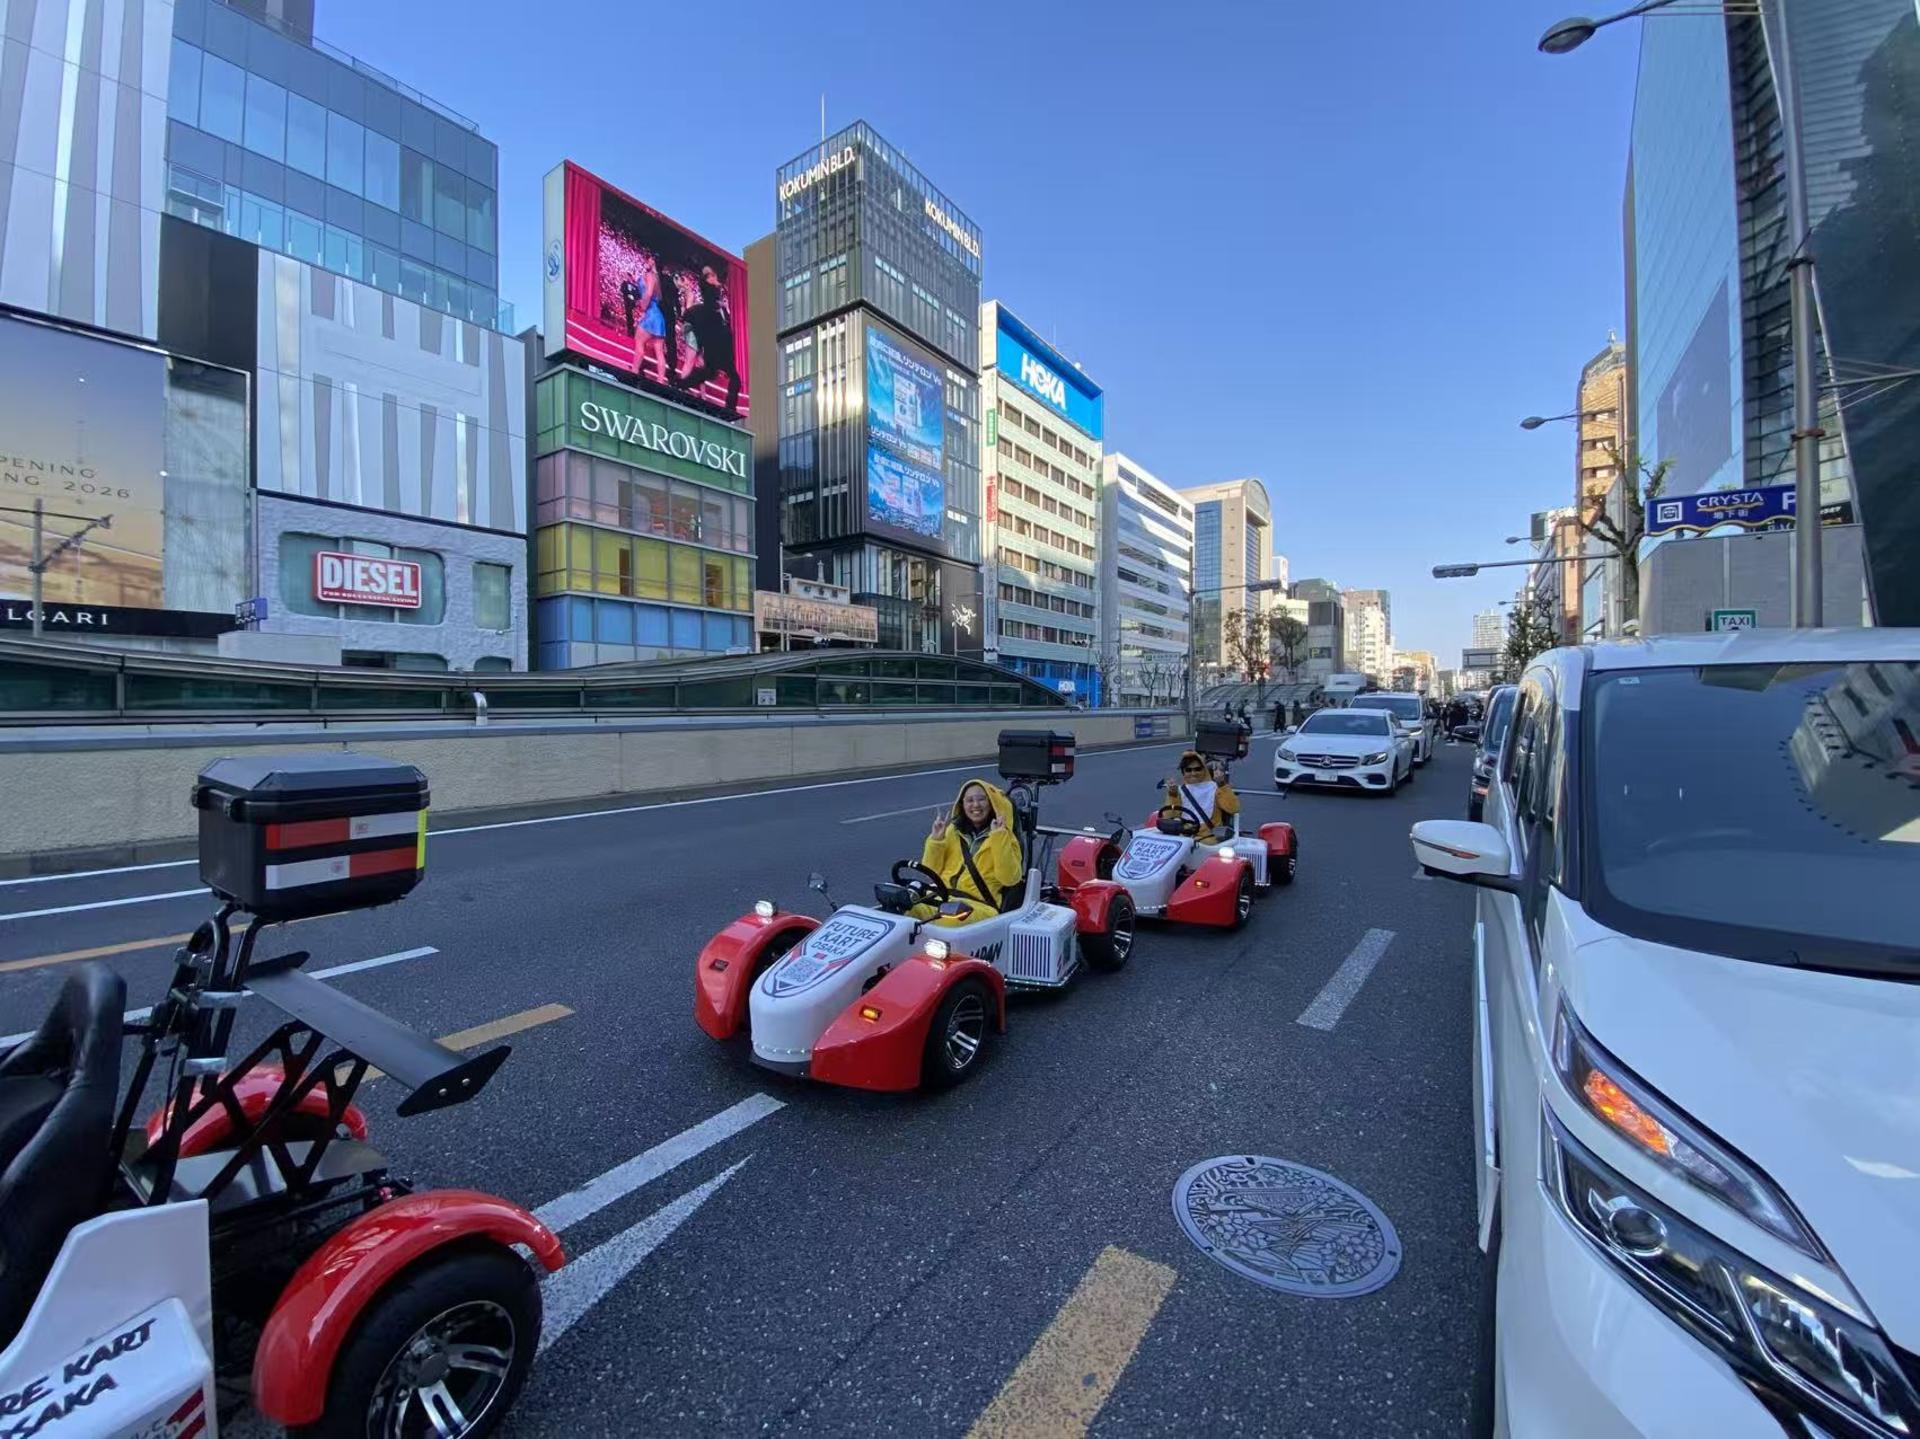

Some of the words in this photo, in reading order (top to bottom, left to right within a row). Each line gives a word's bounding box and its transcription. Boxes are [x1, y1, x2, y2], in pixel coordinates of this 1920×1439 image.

[779, 158, 829, 201] KOKUMIN
[924, 197, 964, 244] KOKUMIN
[1020, 352, 1067, 411] HOKA
[580, 401, 747, 478] SWAROVSKI
[64, 481, 129, 499] 2026
[1696, 491, 1764, 509] CRYSTA
[323, 556, 418, 597] DIESEL
[1720, 615, 1750, 626] TAXI
[820, 931, 863, 948] KART
[825, 921, 879, 940] FUTURE
[811, 942, 848, 956] OSAKA
[64, 1318, 157, 1384] KART
